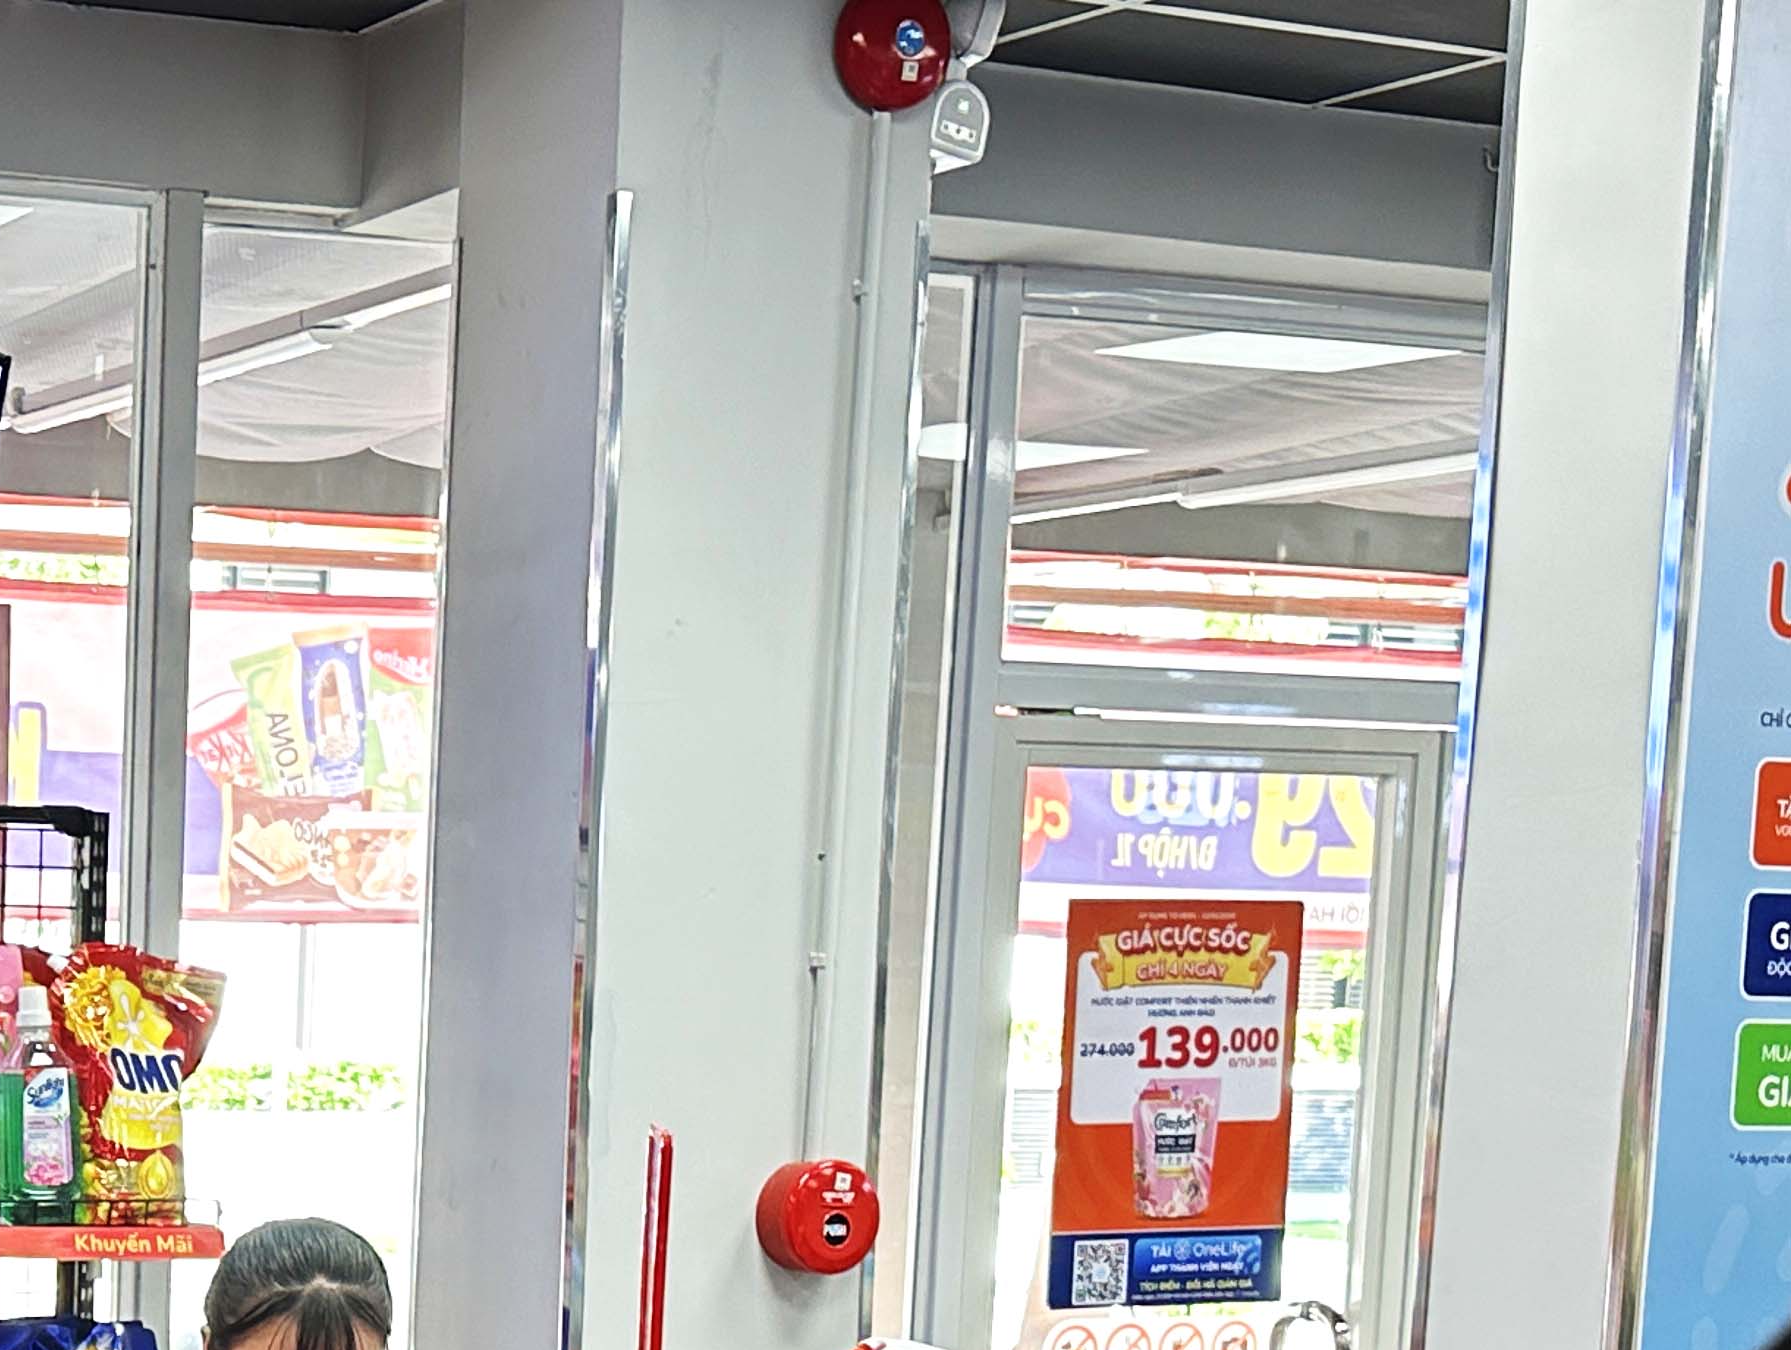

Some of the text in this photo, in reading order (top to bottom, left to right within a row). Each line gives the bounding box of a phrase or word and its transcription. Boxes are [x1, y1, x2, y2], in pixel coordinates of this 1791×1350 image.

[1117, 923, 1250, 955] GIÁ CỰC SỐC
[1136, 961, 1228, 980] CHỈ NGÀY
[1137, 1025, 1279, 1069] 139.000
[111, 1047, 184, 1095] OMO
[75, 1231, 194, 1257] Khuyến Mãi
